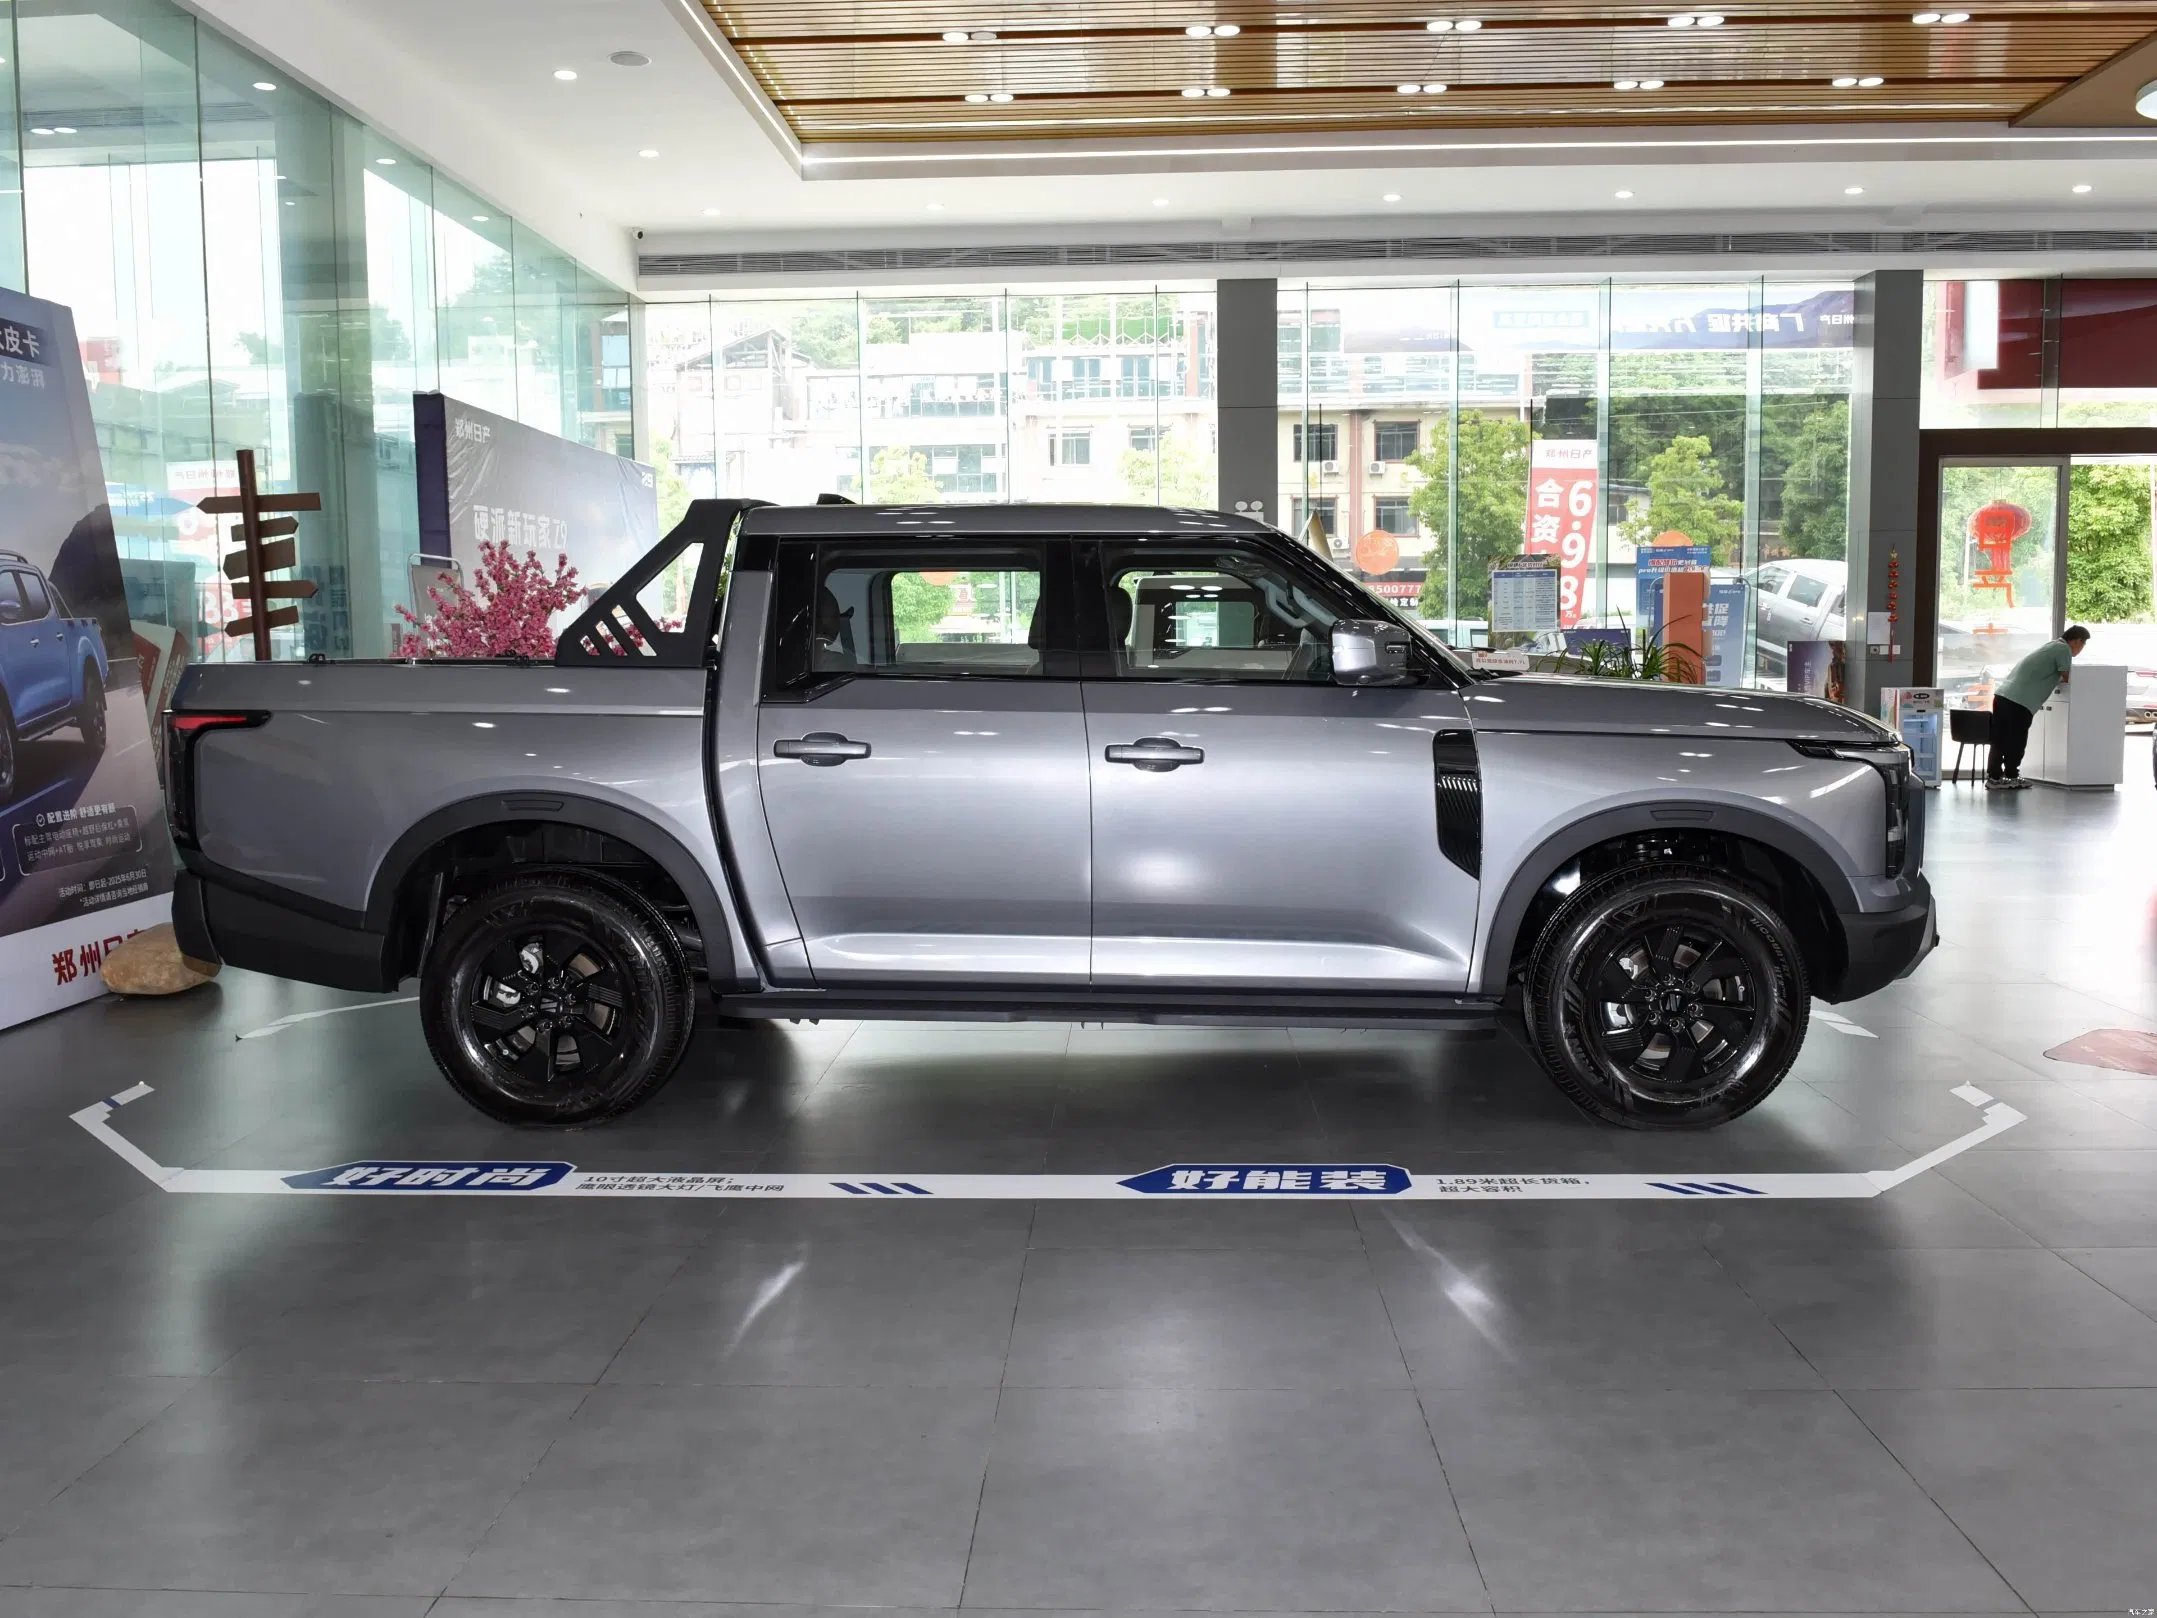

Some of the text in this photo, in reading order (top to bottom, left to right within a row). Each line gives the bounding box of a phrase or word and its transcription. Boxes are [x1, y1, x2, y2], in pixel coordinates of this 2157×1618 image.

[0, 325, 40, 358] 皮卡
[454, 418, 491, 443] 郑州日产
[1546, 449, 1593, 459] 郑州日产
[1530, 477, 1565, 554] 合资
[52, 928, 145, 986] 郑州
[320, 1167, 551, 1187] 好时尚
[1171, 1168, 1389, 1191] 好能装
